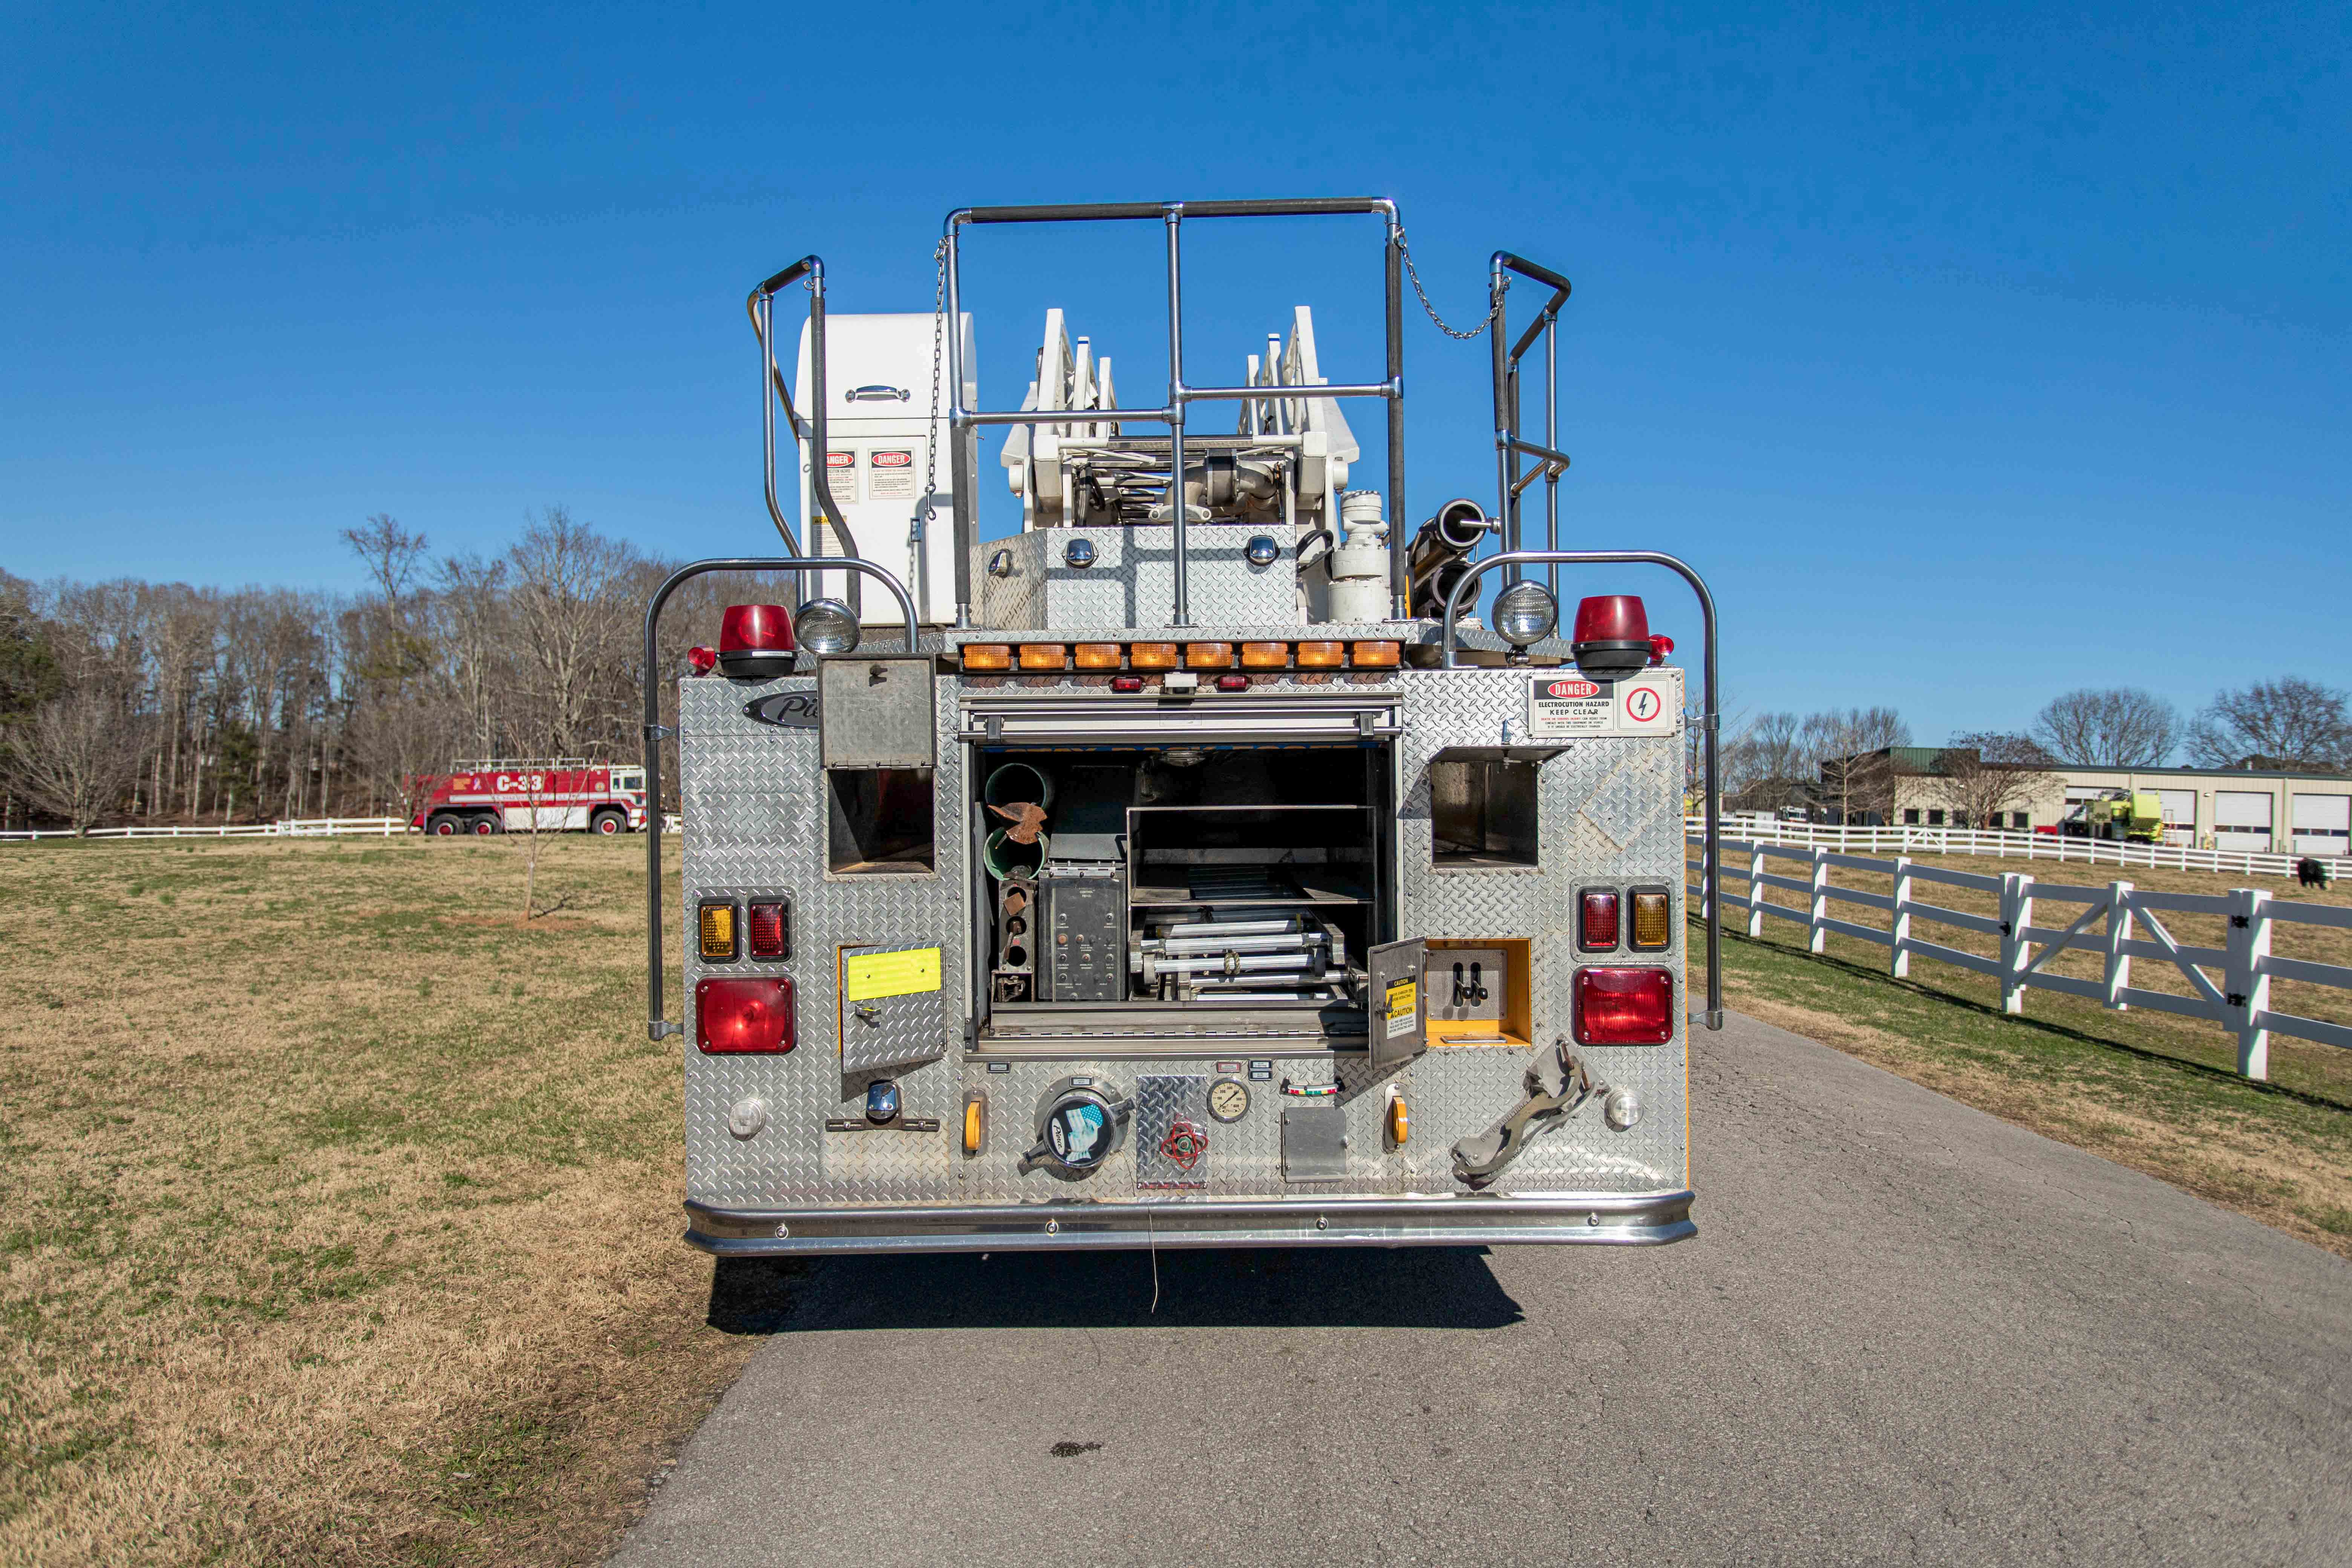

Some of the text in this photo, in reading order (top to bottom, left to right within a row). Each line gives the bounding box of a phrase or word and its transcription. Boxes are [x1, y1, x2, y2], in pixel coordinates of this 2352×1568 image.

[827, 455, 848, 464] ANGER
[878, 455, 905, 464] DANGER
[1555, 683, 1592, 695] DANGER
[496, 775, 542, 791] C-33
[1394, 978, 1408, 986] CAUTION
[1394, 1007, 1412, 1017] CAUTION
[1053, 1125, 1063, 1148] Pierce
